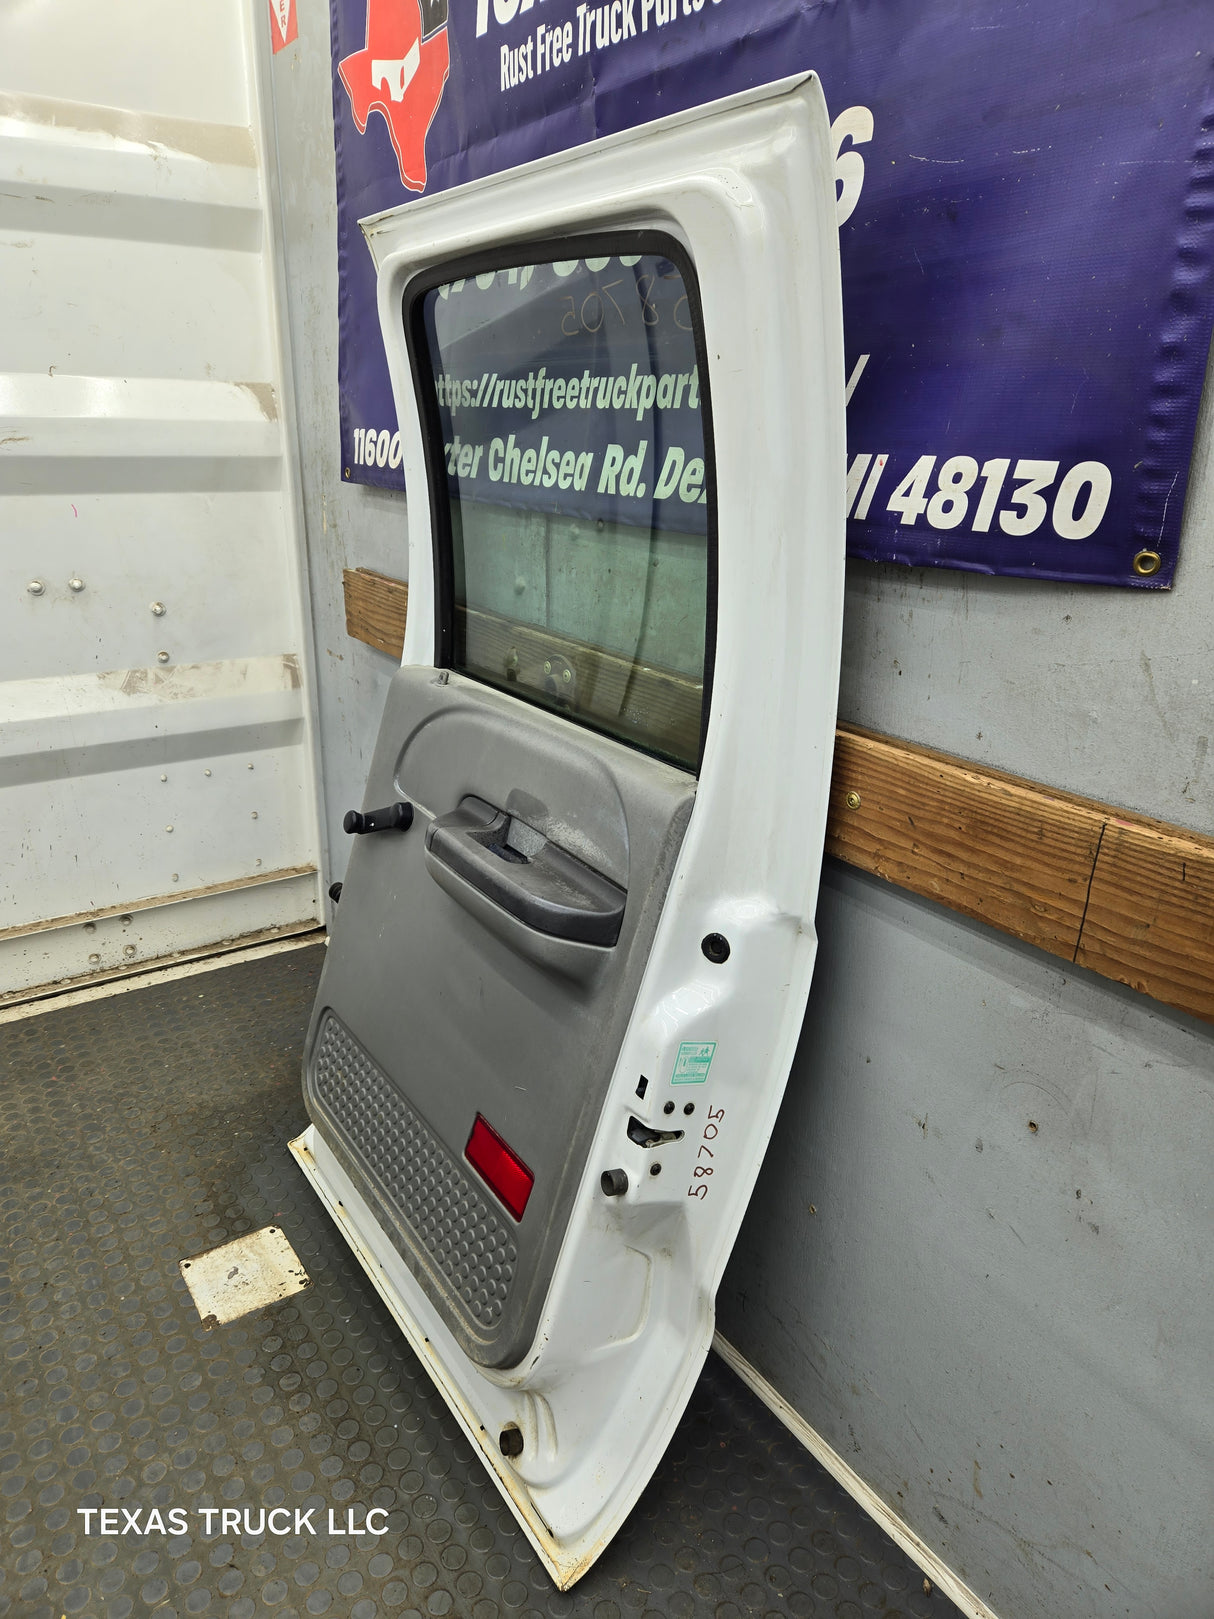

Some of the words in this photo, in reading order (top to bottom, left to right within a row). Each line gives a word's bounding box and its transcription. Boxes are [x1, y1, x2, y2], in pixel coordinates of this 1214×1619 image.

[500, 35, 534, 92] Rust
[536, 21, 573, 75] Free
[576, 0, 637, 57] Truck
[435, 363, 701, 422] ttps://rustfreetruckpart
[353, 427, 404, 470] 11600
[443, 435, 484, 479] ter
[488, 433, 594, 491] Chelsea
[597, 440, 649, 499] Rd.
[653, 446, 708, 504] De
[886, 455, 1113, 540] 48130
[688, 1104, 726, 1201] 58705
